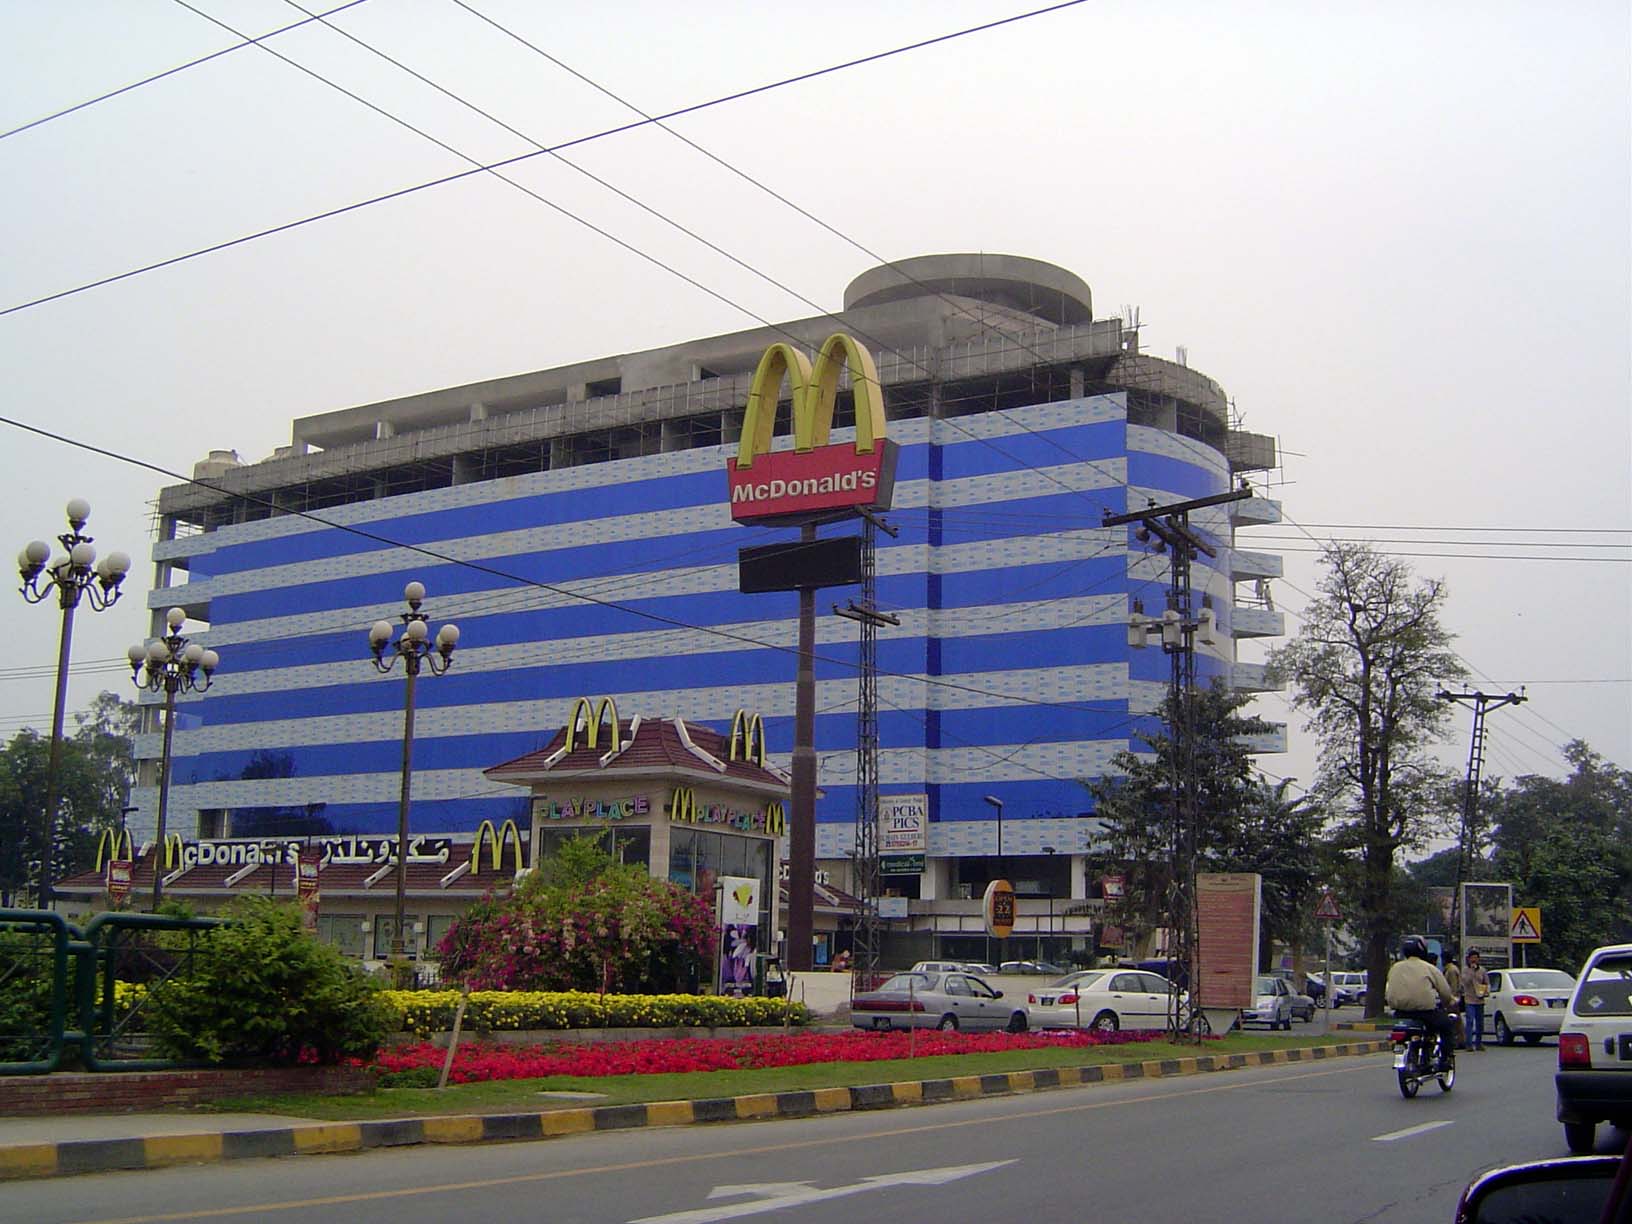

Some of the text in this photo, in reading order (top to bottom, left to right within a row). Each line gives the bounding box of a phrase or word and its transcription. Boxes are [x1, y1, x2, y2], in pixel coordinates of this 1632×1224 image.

[731, 470, 876, 503] McDonald's
[893, 803, 924, 817] PCBA
[893, 817, 920, 829] PICS
